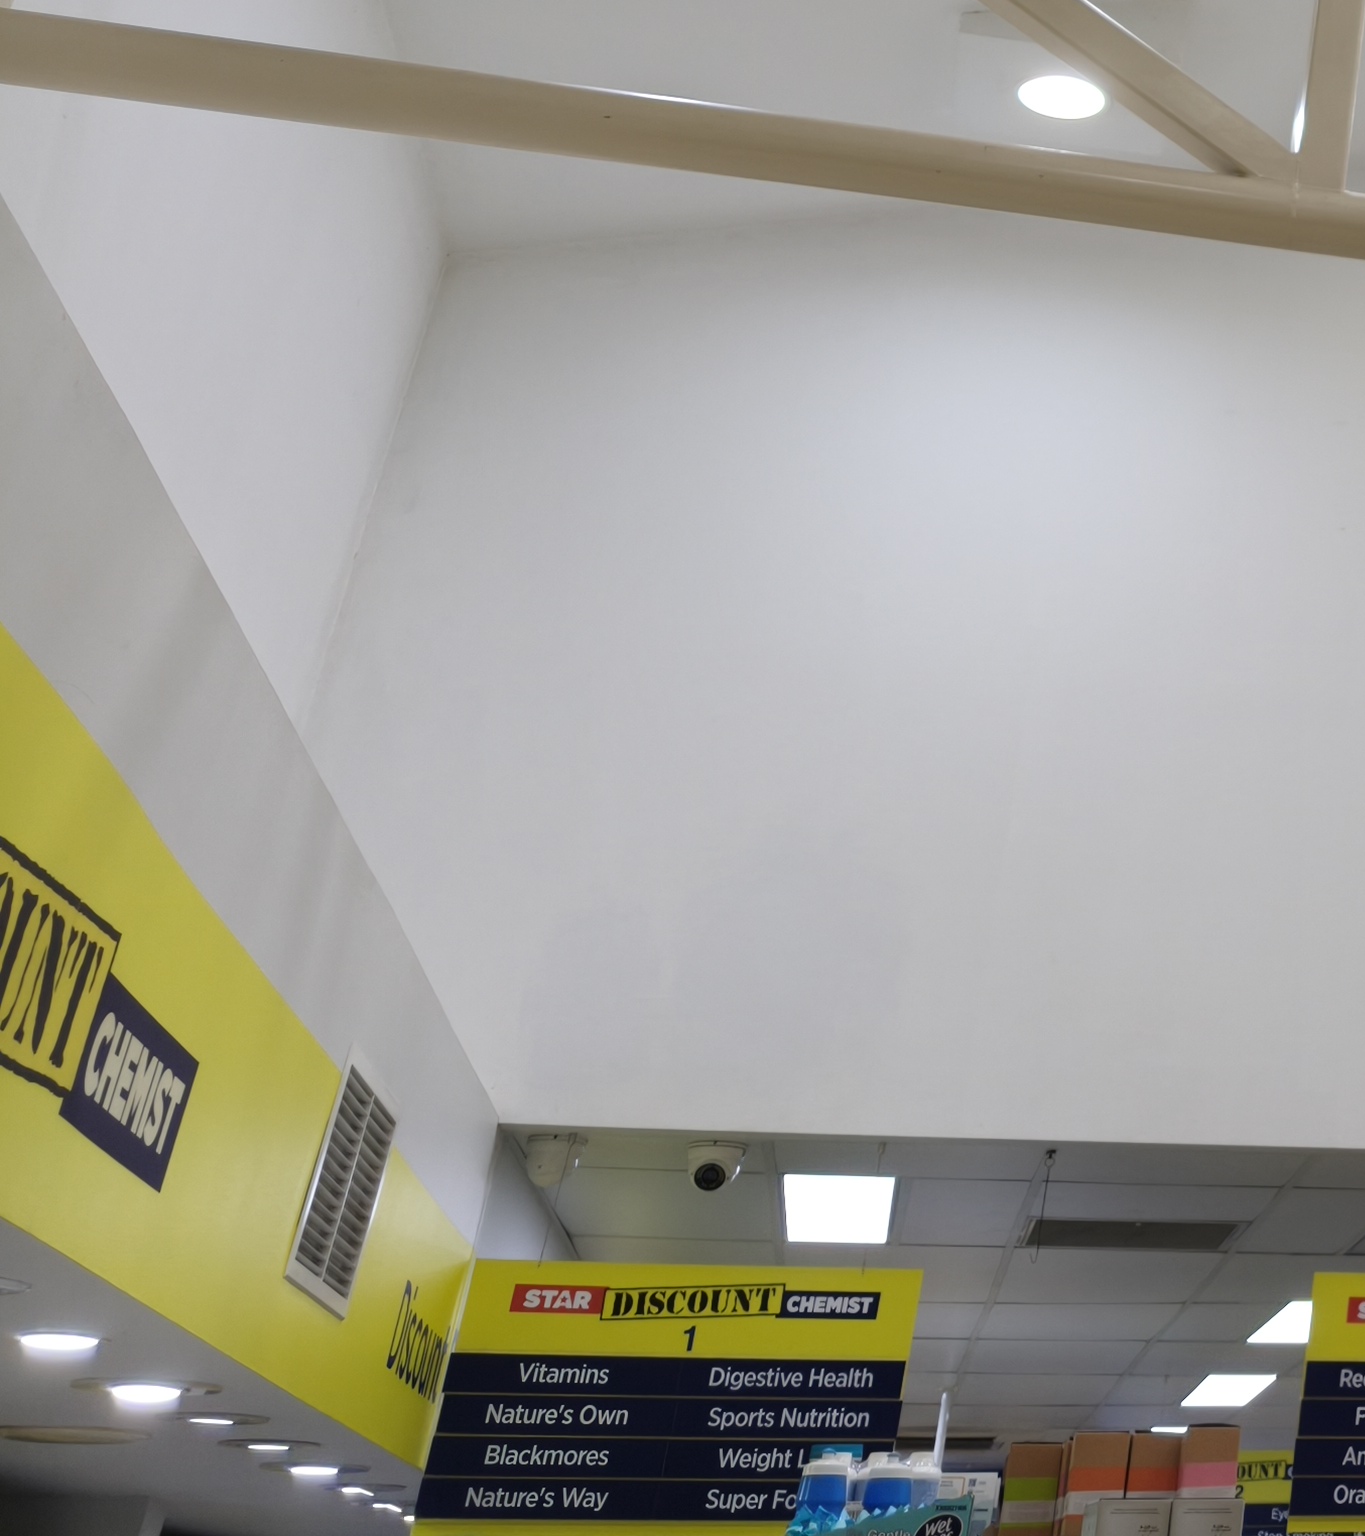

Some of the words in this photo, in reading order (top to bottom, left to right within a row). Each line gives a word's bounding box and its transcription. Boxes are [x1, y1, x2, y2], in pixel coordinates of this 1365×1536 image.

[84, 1010, 187, 1156] CHEMIST
[522, 1289, 593, 1310] STAR
[610, 1287, 777, 1318] DISCOUNT
[786, 1296, 874, 1314] CHEMIST
[386, 1279, 452, 1404] Discount
[683, 1325, 698, 1353] 1
[518, 1362, 609, 1385] Vitamins
[708, 1367, 803, 1390] Digestive
[808, 1368, 874, 1389] Health
[485, 1403, 576, 1426] Nature's
[580, 1405, 629, 1426] Own
[707, 1407, 775, 1431] Sports
[780, 1407, 870, 1428] Nutrition
[484, 1445, 609, 1467] Blackmores
[718, 1448, 792, 1472] Weight
[797, 1448, 809, 1468] L
[464, 1486, 555, 1509] Nature's
[559, 1487, 609, 1512] Way
[705, 1489, 767, 1514] Super
[772, 1489, 798, 1511] Fo
